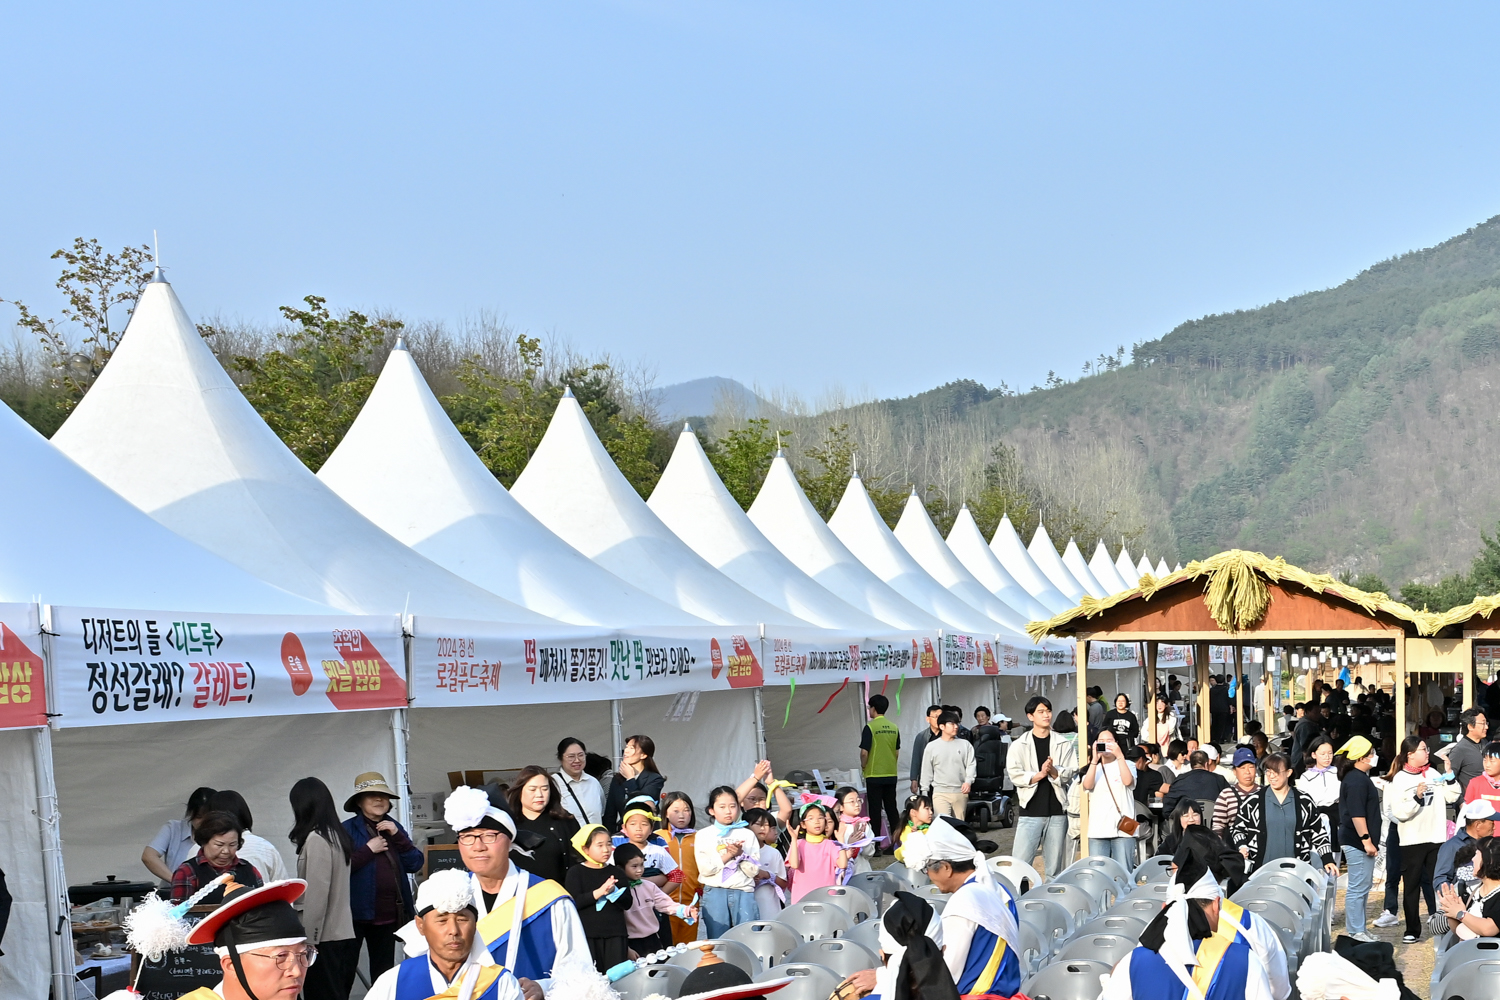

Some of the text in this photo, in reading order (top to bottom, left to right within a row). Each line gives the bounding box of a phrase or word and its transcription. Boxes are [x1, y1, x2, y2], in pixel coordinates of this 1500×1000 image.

[81, 618, 223, 656] 디저트의 들 <디드루>
[333, 629, 362, 651] 추억의
[437, 637, 457, 657] 2024
[321, 660, 381, 693] 옛날 밥상
[436, 660, 502, 692] 로컬푸드축제
[524, 639, 536, 685] 떡
[570, 648, 607, 682] 쫄깃쫄깃!
[610, 639, 630, 681] 맛난
[633, 639, 643, 680] 떡
[644, 647, 668, 679] 맛보러
[669, 647, 695, 677] 오세요~
[774, 654, 807, 675] 로컬푸드축제
[86, 661, 256, 713] 정선갈래? 갈레트!
